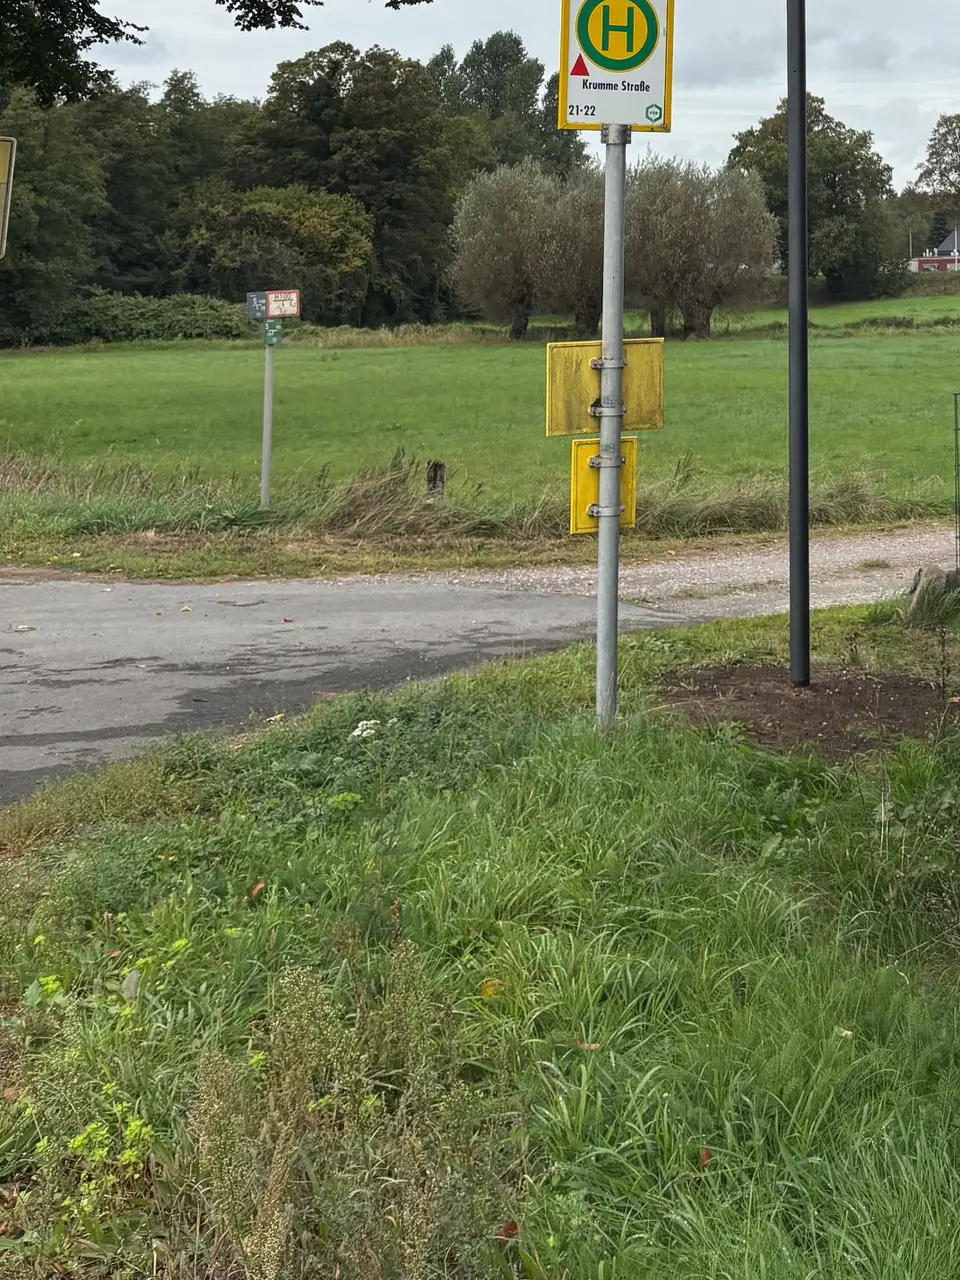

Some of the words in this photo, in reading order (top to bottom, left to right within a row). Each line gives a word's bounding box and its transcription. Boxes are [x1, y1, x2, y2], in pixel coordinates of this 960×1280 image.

[601, 4, 635, 53] H
[582, 79, 619, 91] Krumme
[621, 81, 650, 92] Straße
